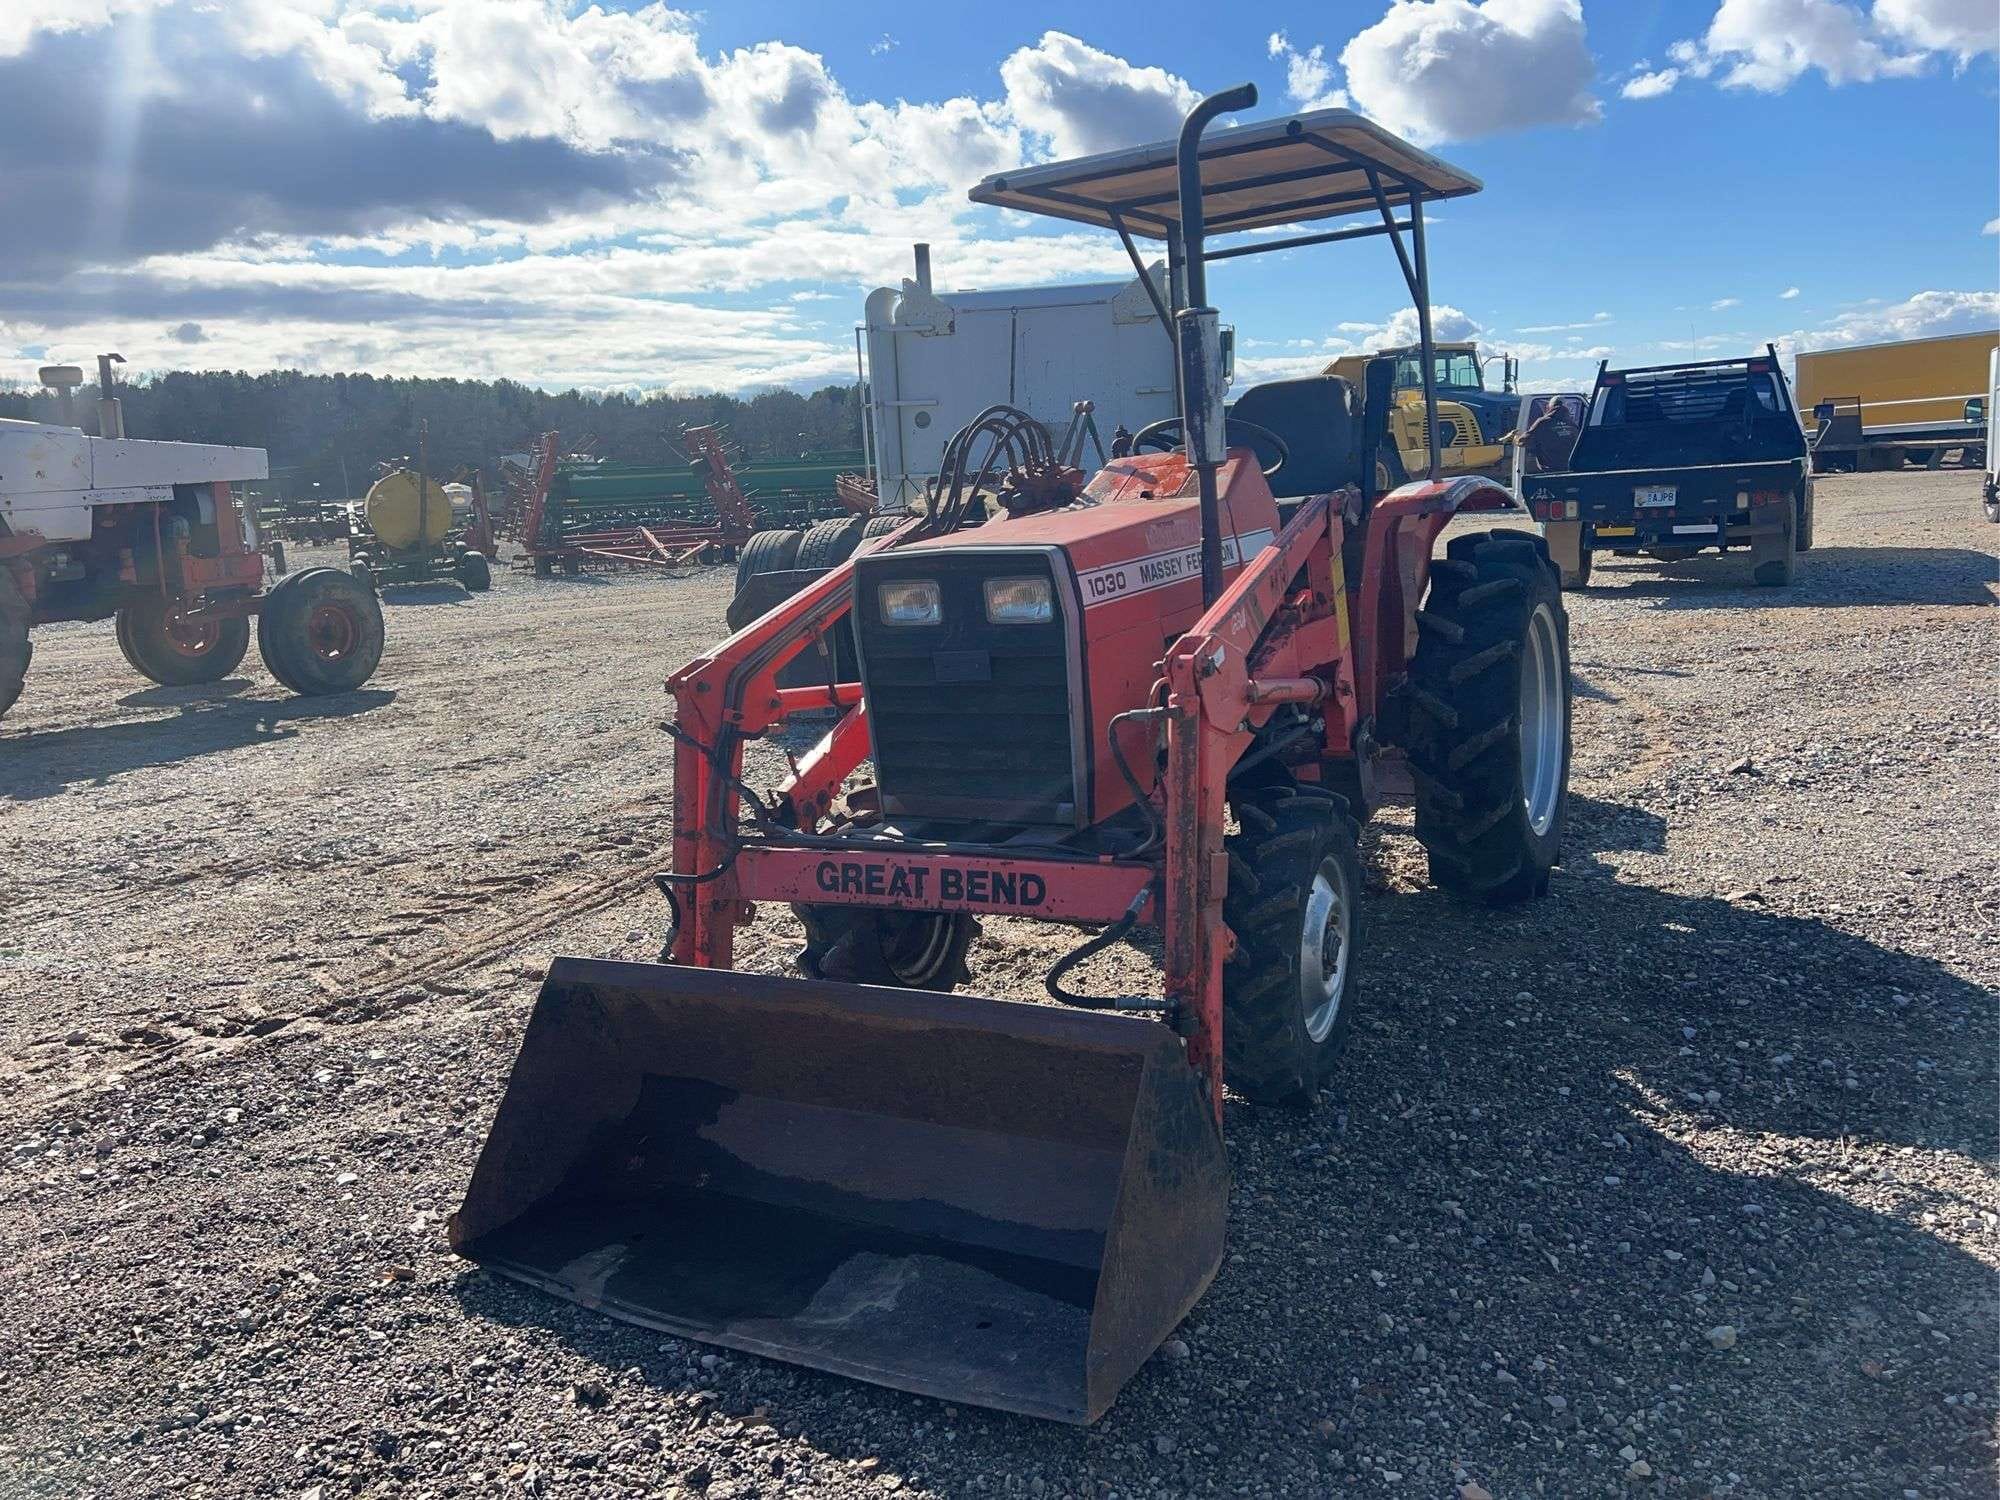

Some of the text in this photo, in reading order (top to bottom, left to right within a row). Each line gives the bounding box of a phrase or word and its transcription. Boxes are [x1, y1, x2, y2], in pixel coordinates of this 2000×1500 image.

[1087, 571, 1127, 597] 1030
[1140, 557, 1183, 584] MASSEY
[815, 861, 1046, 906] GREAT BEND
